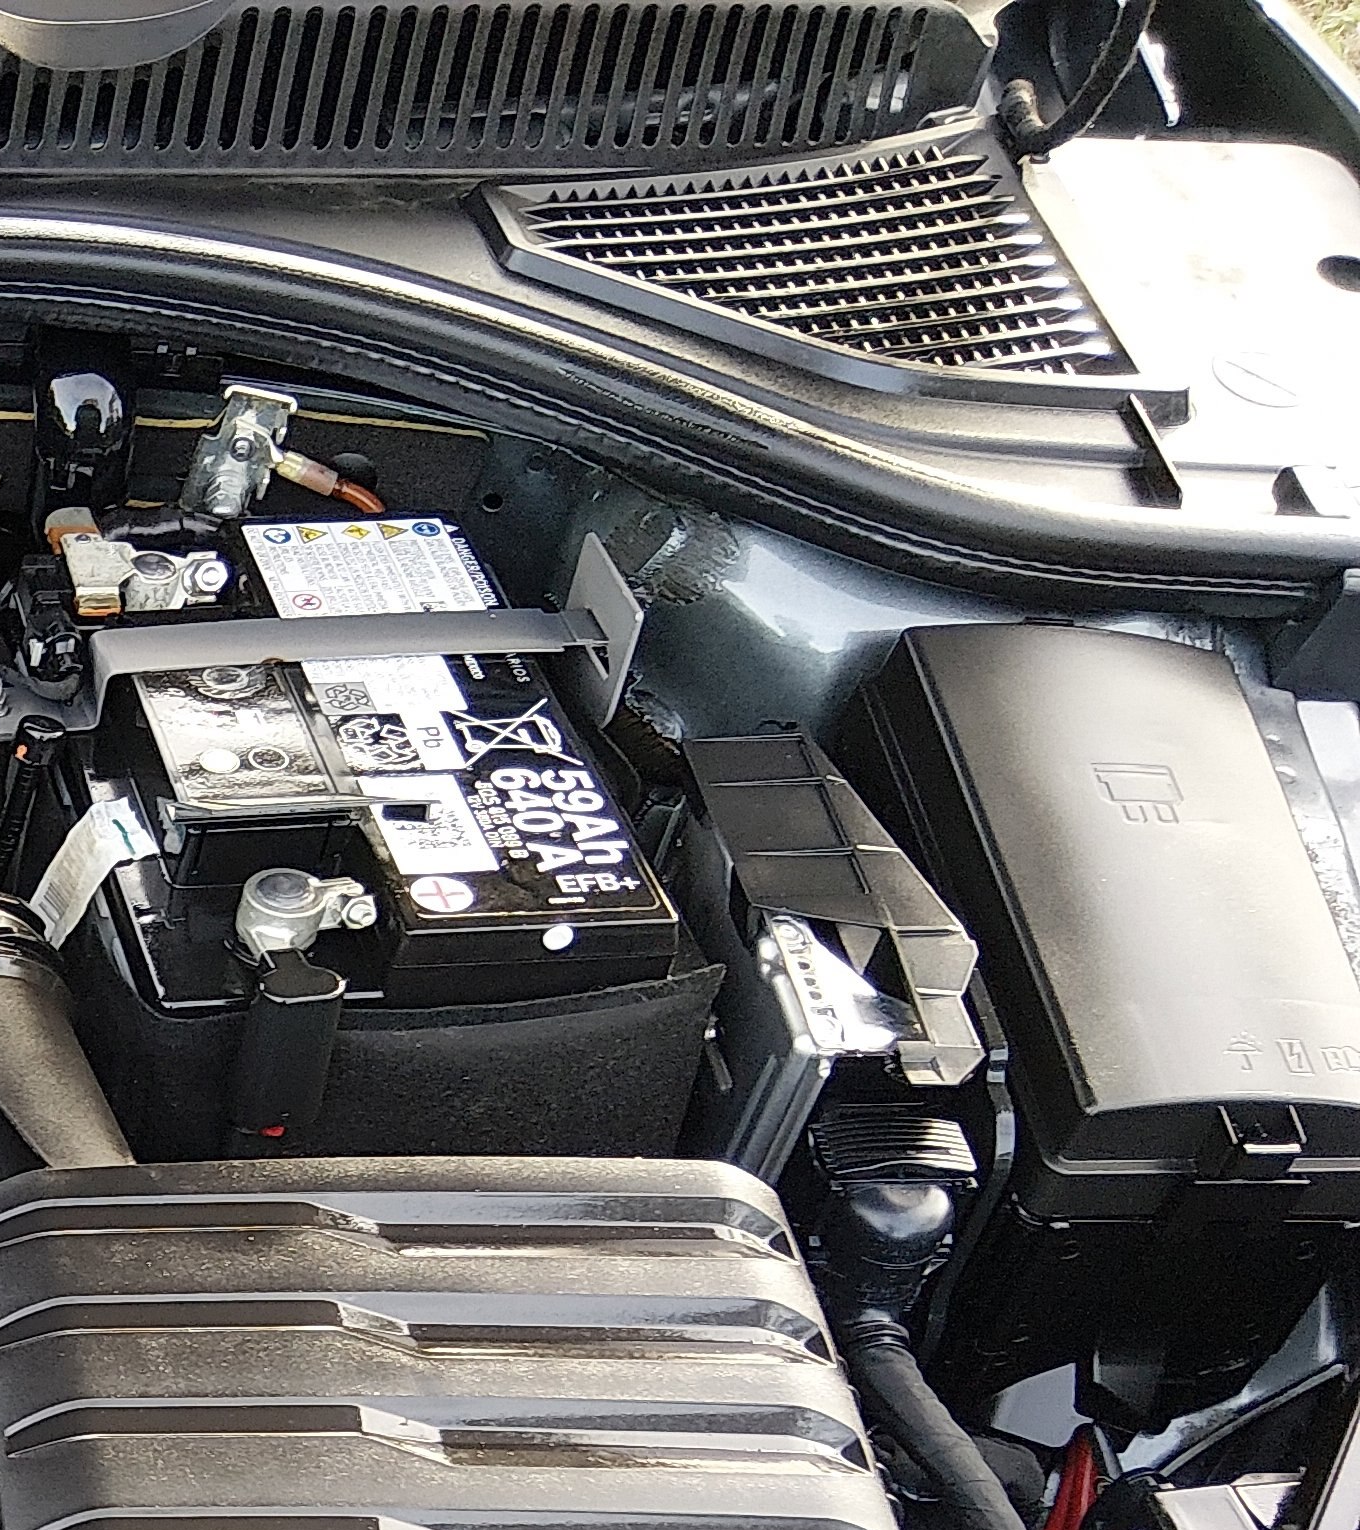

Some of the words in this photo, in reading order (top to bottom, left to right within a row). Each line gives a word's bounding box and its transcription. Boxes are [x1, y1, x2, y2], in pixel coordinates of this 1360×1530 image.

[451, 537, 500, 608] DANGER/POISON
[505, 653, 531, 683] RIOS
[416, 725, 441, 751] Pb
[490, 767, 568, 834] 640
[540, 768, 630, 866] 59Ah
[526, 842, 585, 873] A
[555, 873, 641, 893] EFB+
